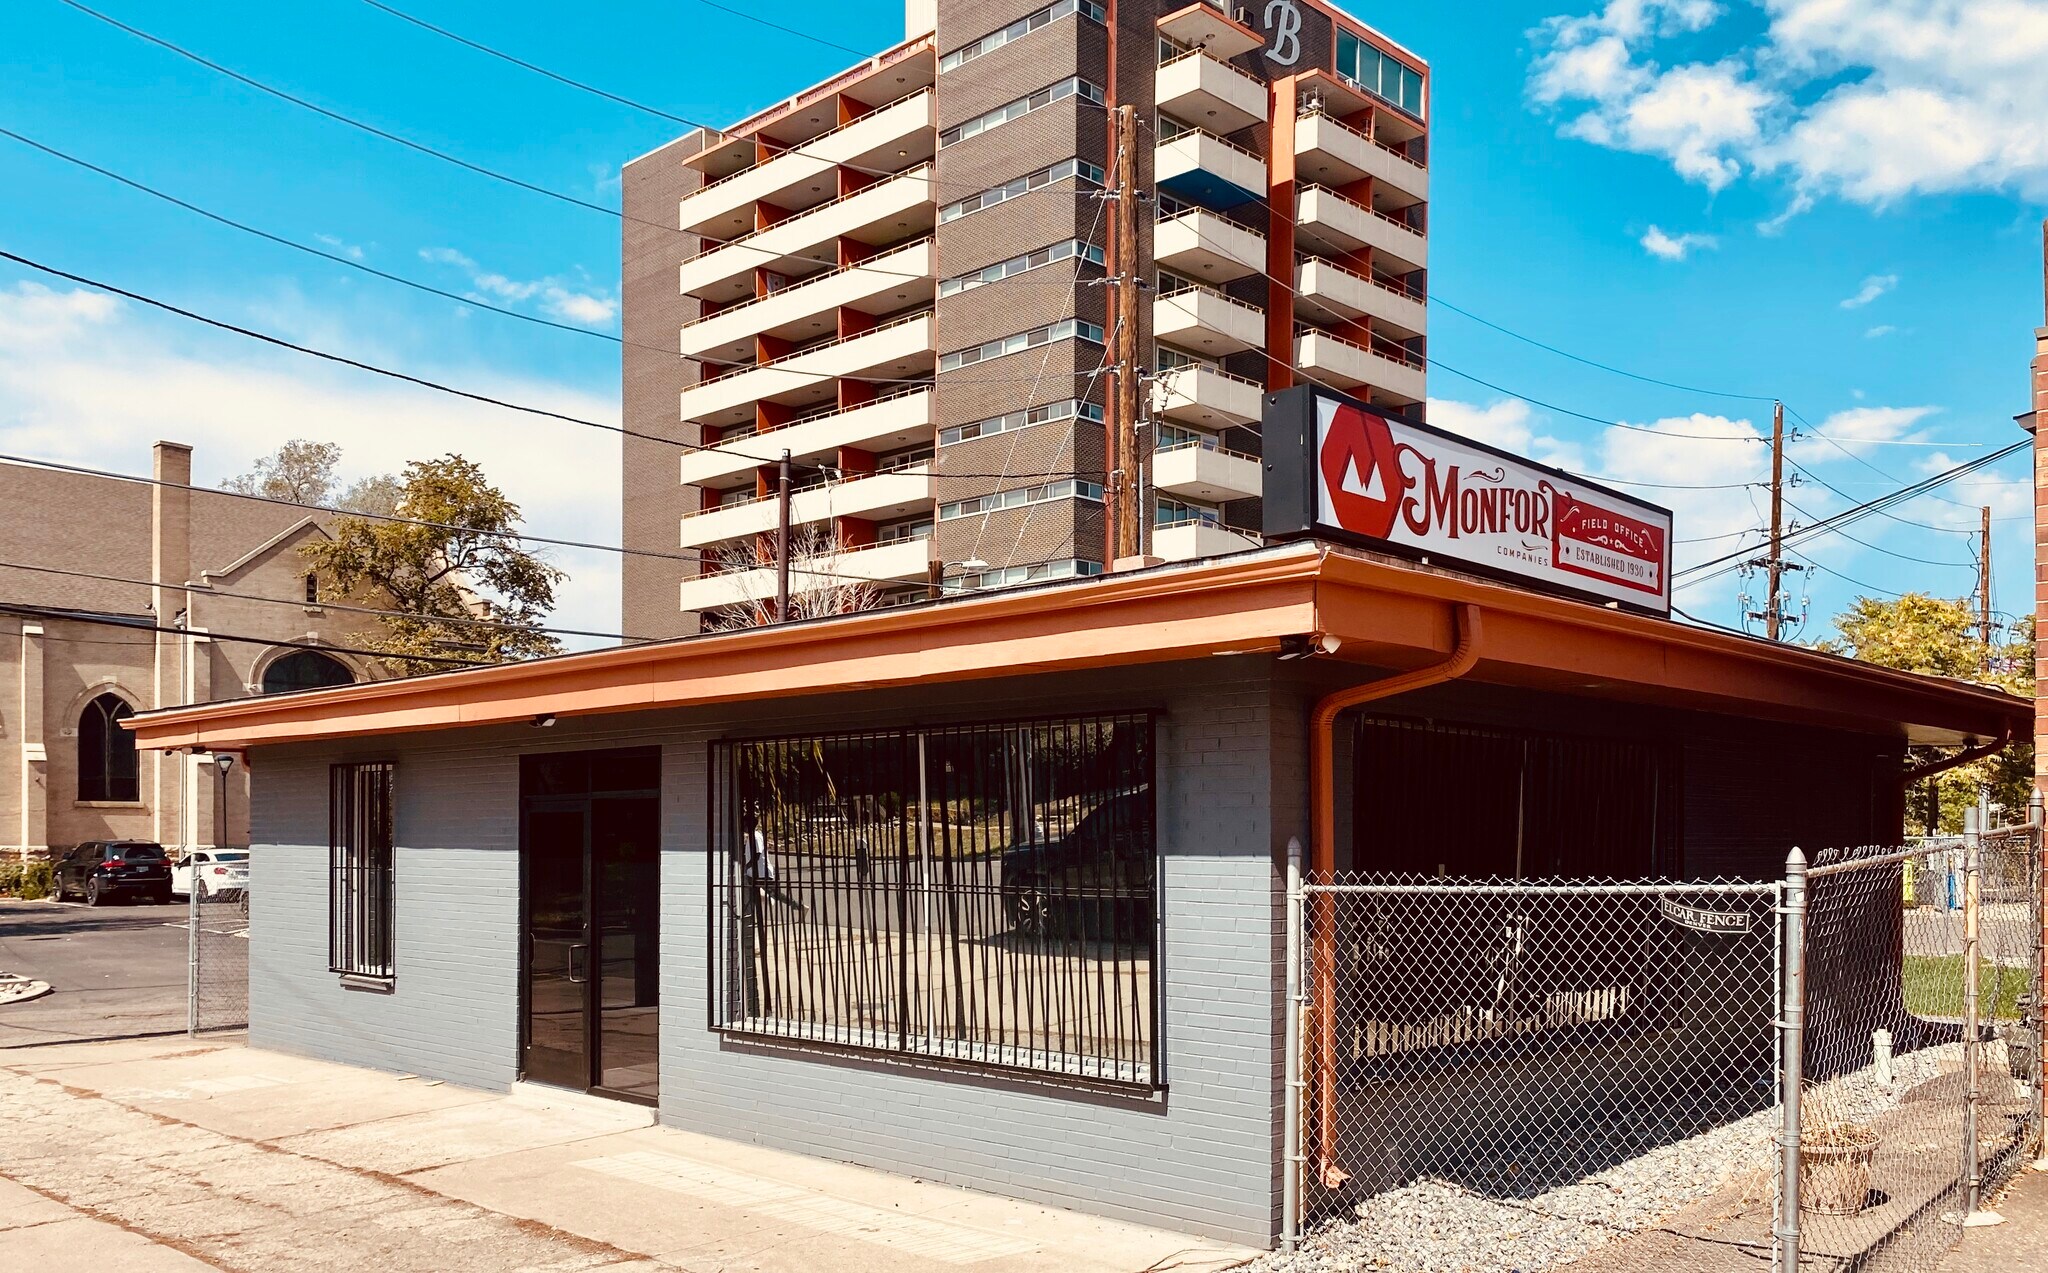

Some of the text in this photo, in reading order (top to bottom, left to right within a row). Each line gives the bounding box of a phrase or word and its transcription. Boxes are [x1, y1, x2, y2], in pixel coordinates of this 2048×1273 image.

[1264, 0, 1301, 66] B
[1581, 518, 1644, 548] FIELD OFFICE
[1497, 545, 1549, 567] COMPANIES
[1576, 546, 1625, 573] ESTABLISHED
[1664, 901, 1745, 927] ELCAR FENCE
